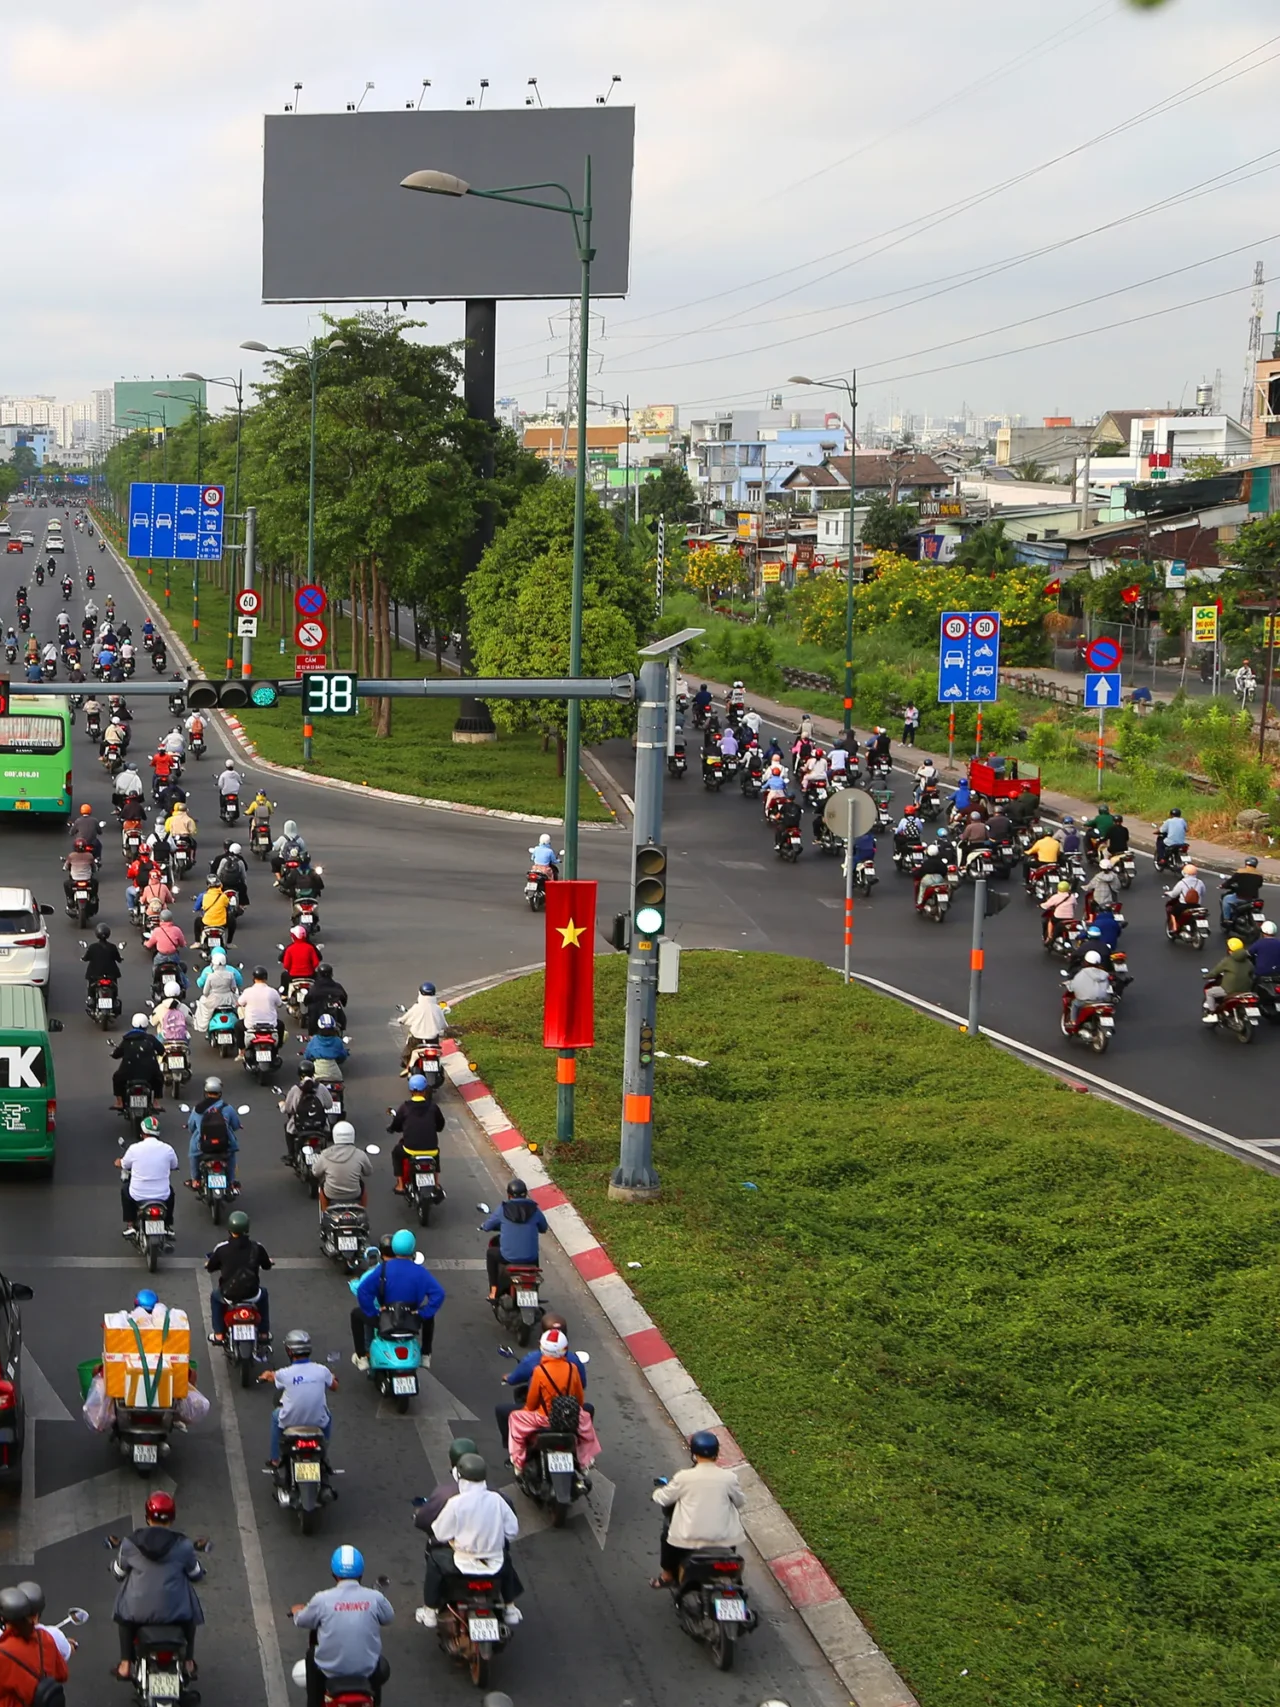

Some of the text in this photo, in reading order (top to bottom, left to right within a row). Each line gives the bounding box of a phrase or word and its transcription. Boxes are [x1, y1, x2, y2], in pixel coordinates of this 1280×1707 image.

[207, 492, 217, 501] 50
[243, 596, 254, 607] 60
[951, 623, 960, 633] 50
[980, 622, 990, 632] 50
[308, 676, 352, 712] 38
